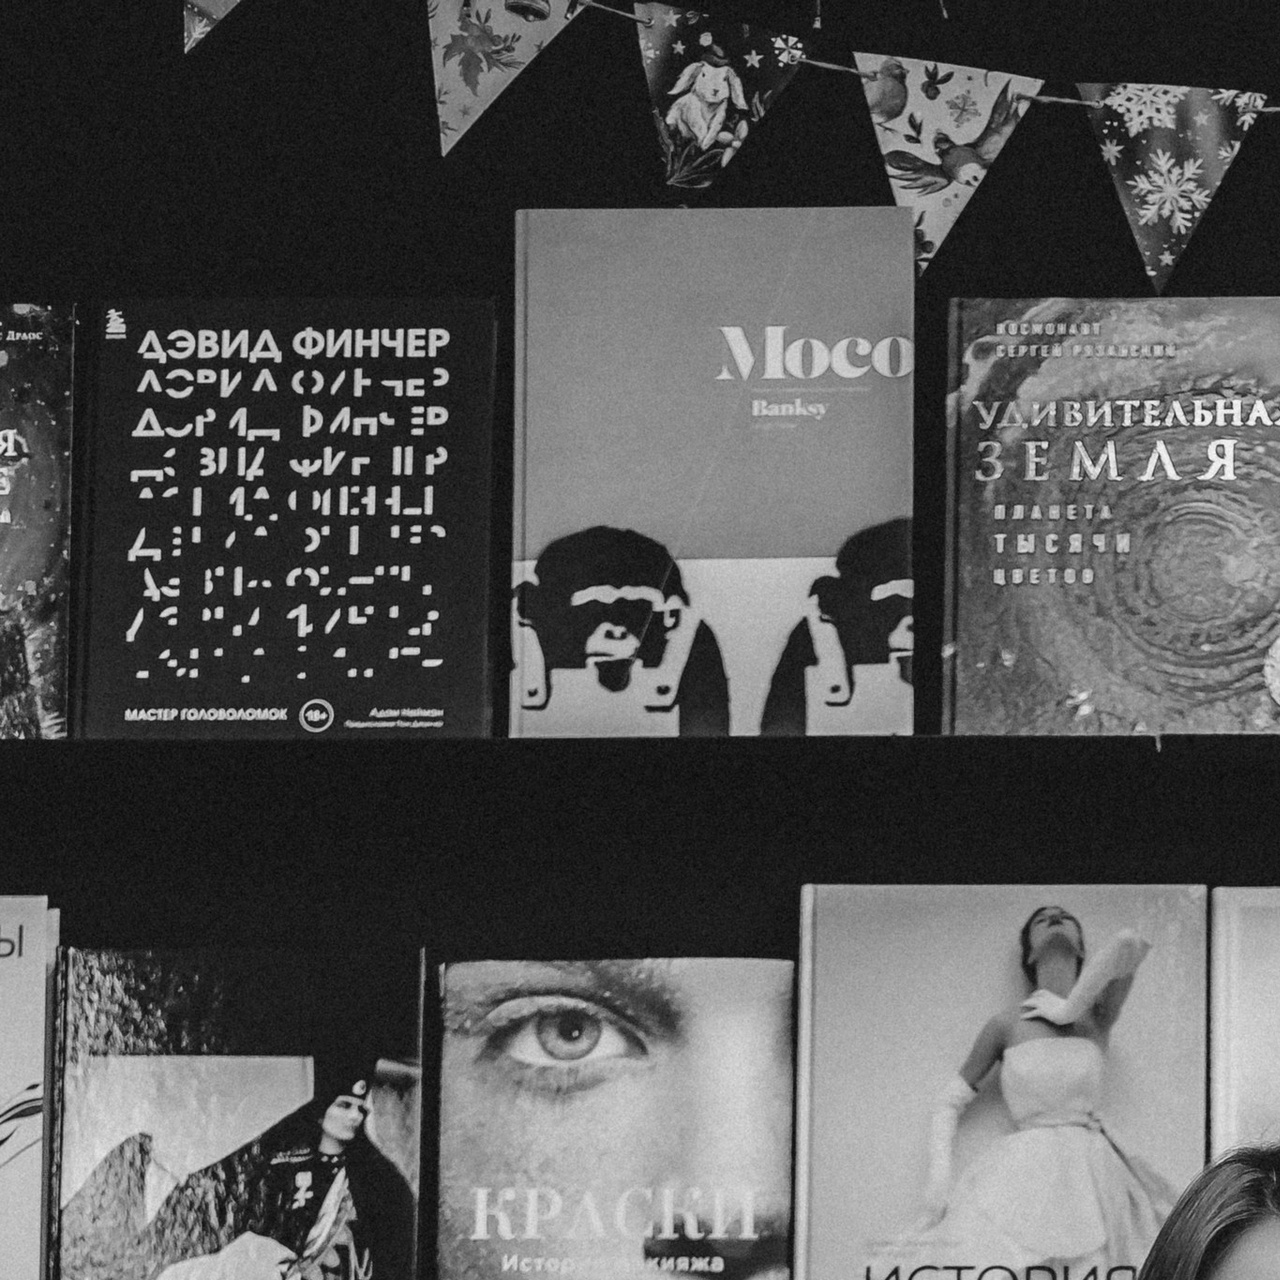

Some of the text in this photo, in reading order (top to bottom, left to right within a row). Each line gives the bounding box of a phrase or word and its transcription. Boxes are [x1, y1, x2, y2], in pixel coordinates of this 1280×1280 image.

[995, 322, 1101, 336] КОСМОНАВТ
[137, 328, 450, 364] ДЭВИД ФИНЧЕР
[714, 325, 915, 382] Moco
[995, 342, 1063, 359] СЕРГЕЙ
[751, 397, 828, 420] Banksy
[974, 438, 1238, 483] ЗЕМЛЯ
[993, 503, 1114, 521] ПЛАНЕТА
[993, 533, 1131, 555] ТЫСЯЧИ
[992, 568, 1096, 587] ЦВЕТОВ
[124, 706, 288, 721] МАСТЕР ГОЛОВОЛОМОК
[305, 707, 328, 723] 18+
[469, 1186, 759, 1241] КРАСКИ
